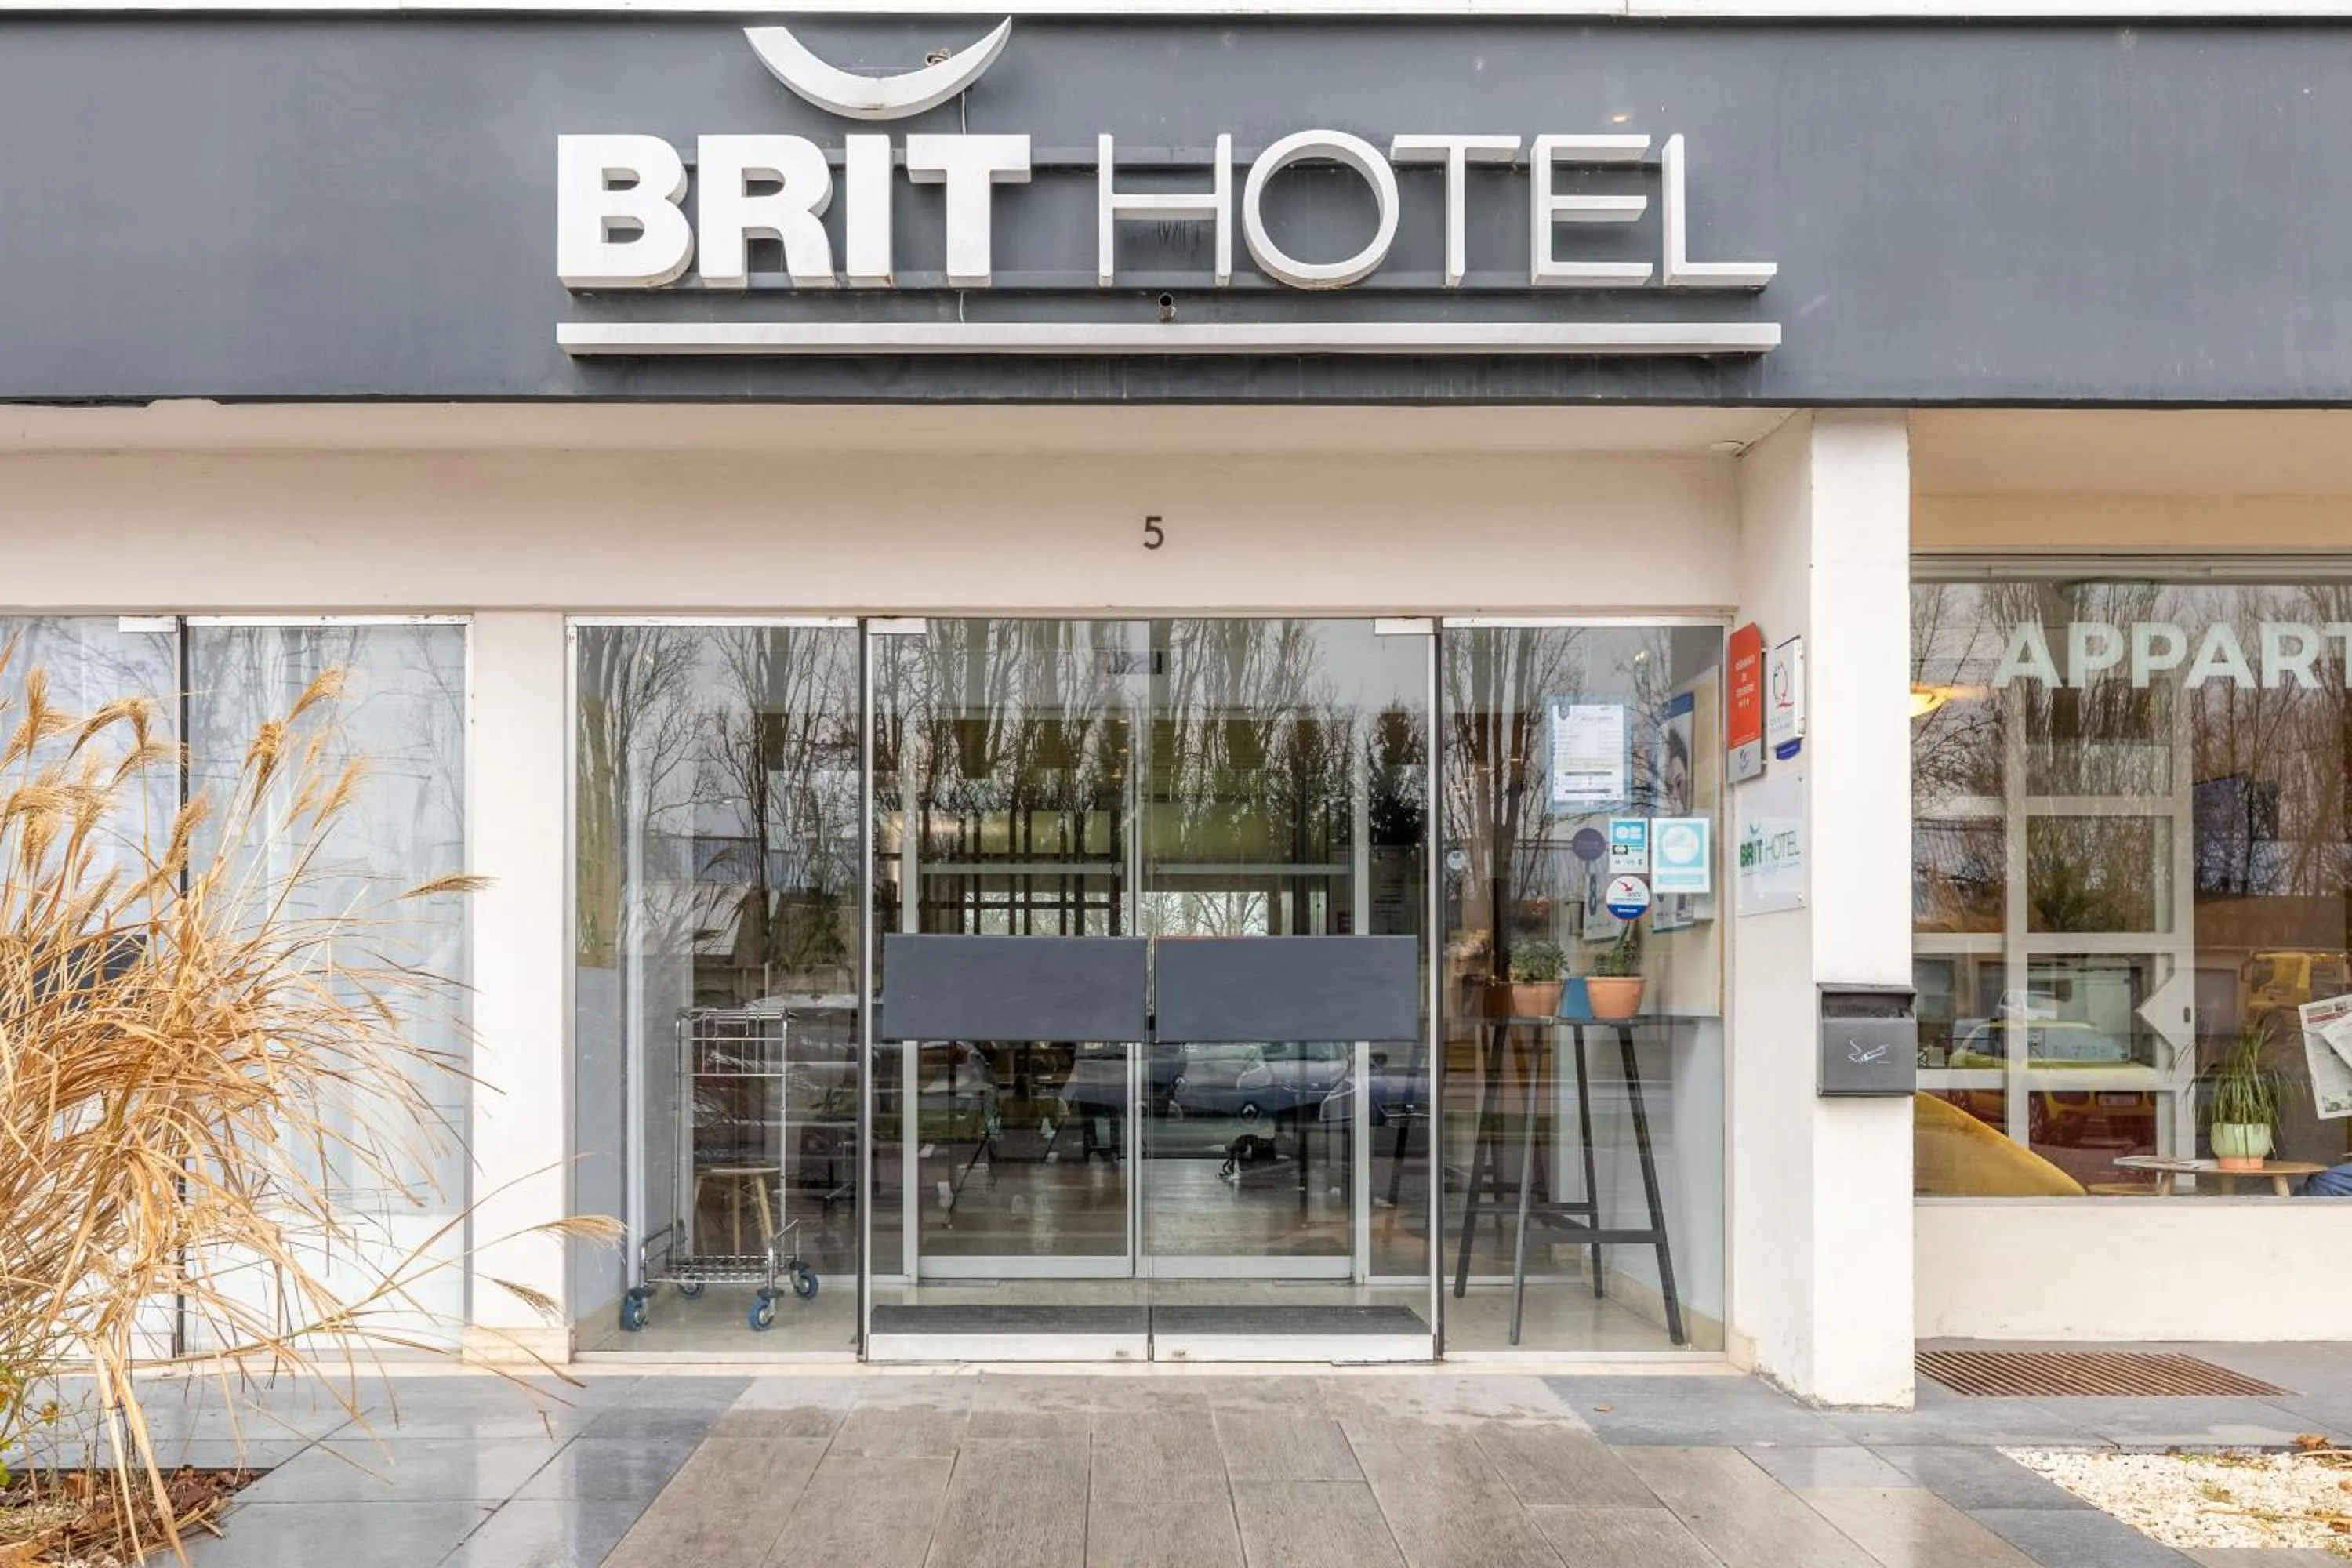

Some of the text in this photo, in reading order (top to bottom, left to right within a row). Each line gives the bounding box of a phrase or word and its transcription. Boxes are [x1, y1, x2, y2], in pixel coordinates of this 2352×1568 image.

[557, 129, 1777, 289] BRIT HOTEL
[1144, 516, 1164, 550] 5
[1740, 830, 1801, 867] BRIT HOTEL
